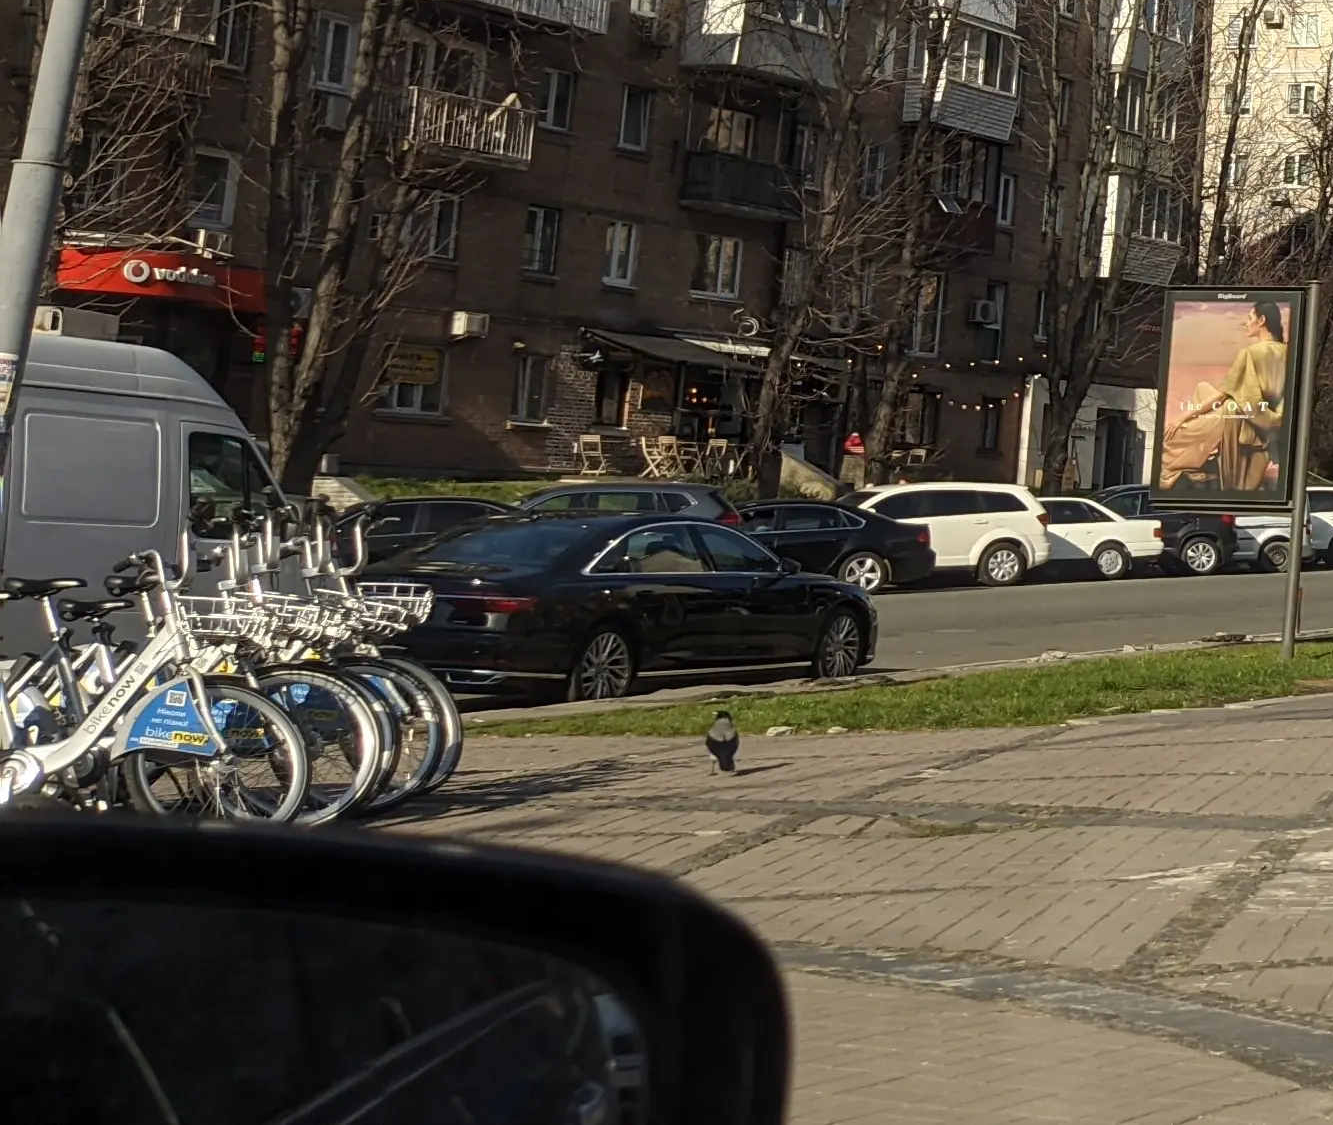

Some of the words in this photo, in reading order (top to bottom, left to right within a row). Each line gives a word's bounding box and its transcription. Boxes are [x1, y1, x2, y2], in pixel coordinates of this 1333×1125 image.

[1180, 400, 1202, 411] the
[1212, 401, 1268, 412] COAT
[83, 676, 135, 735] bikenow
